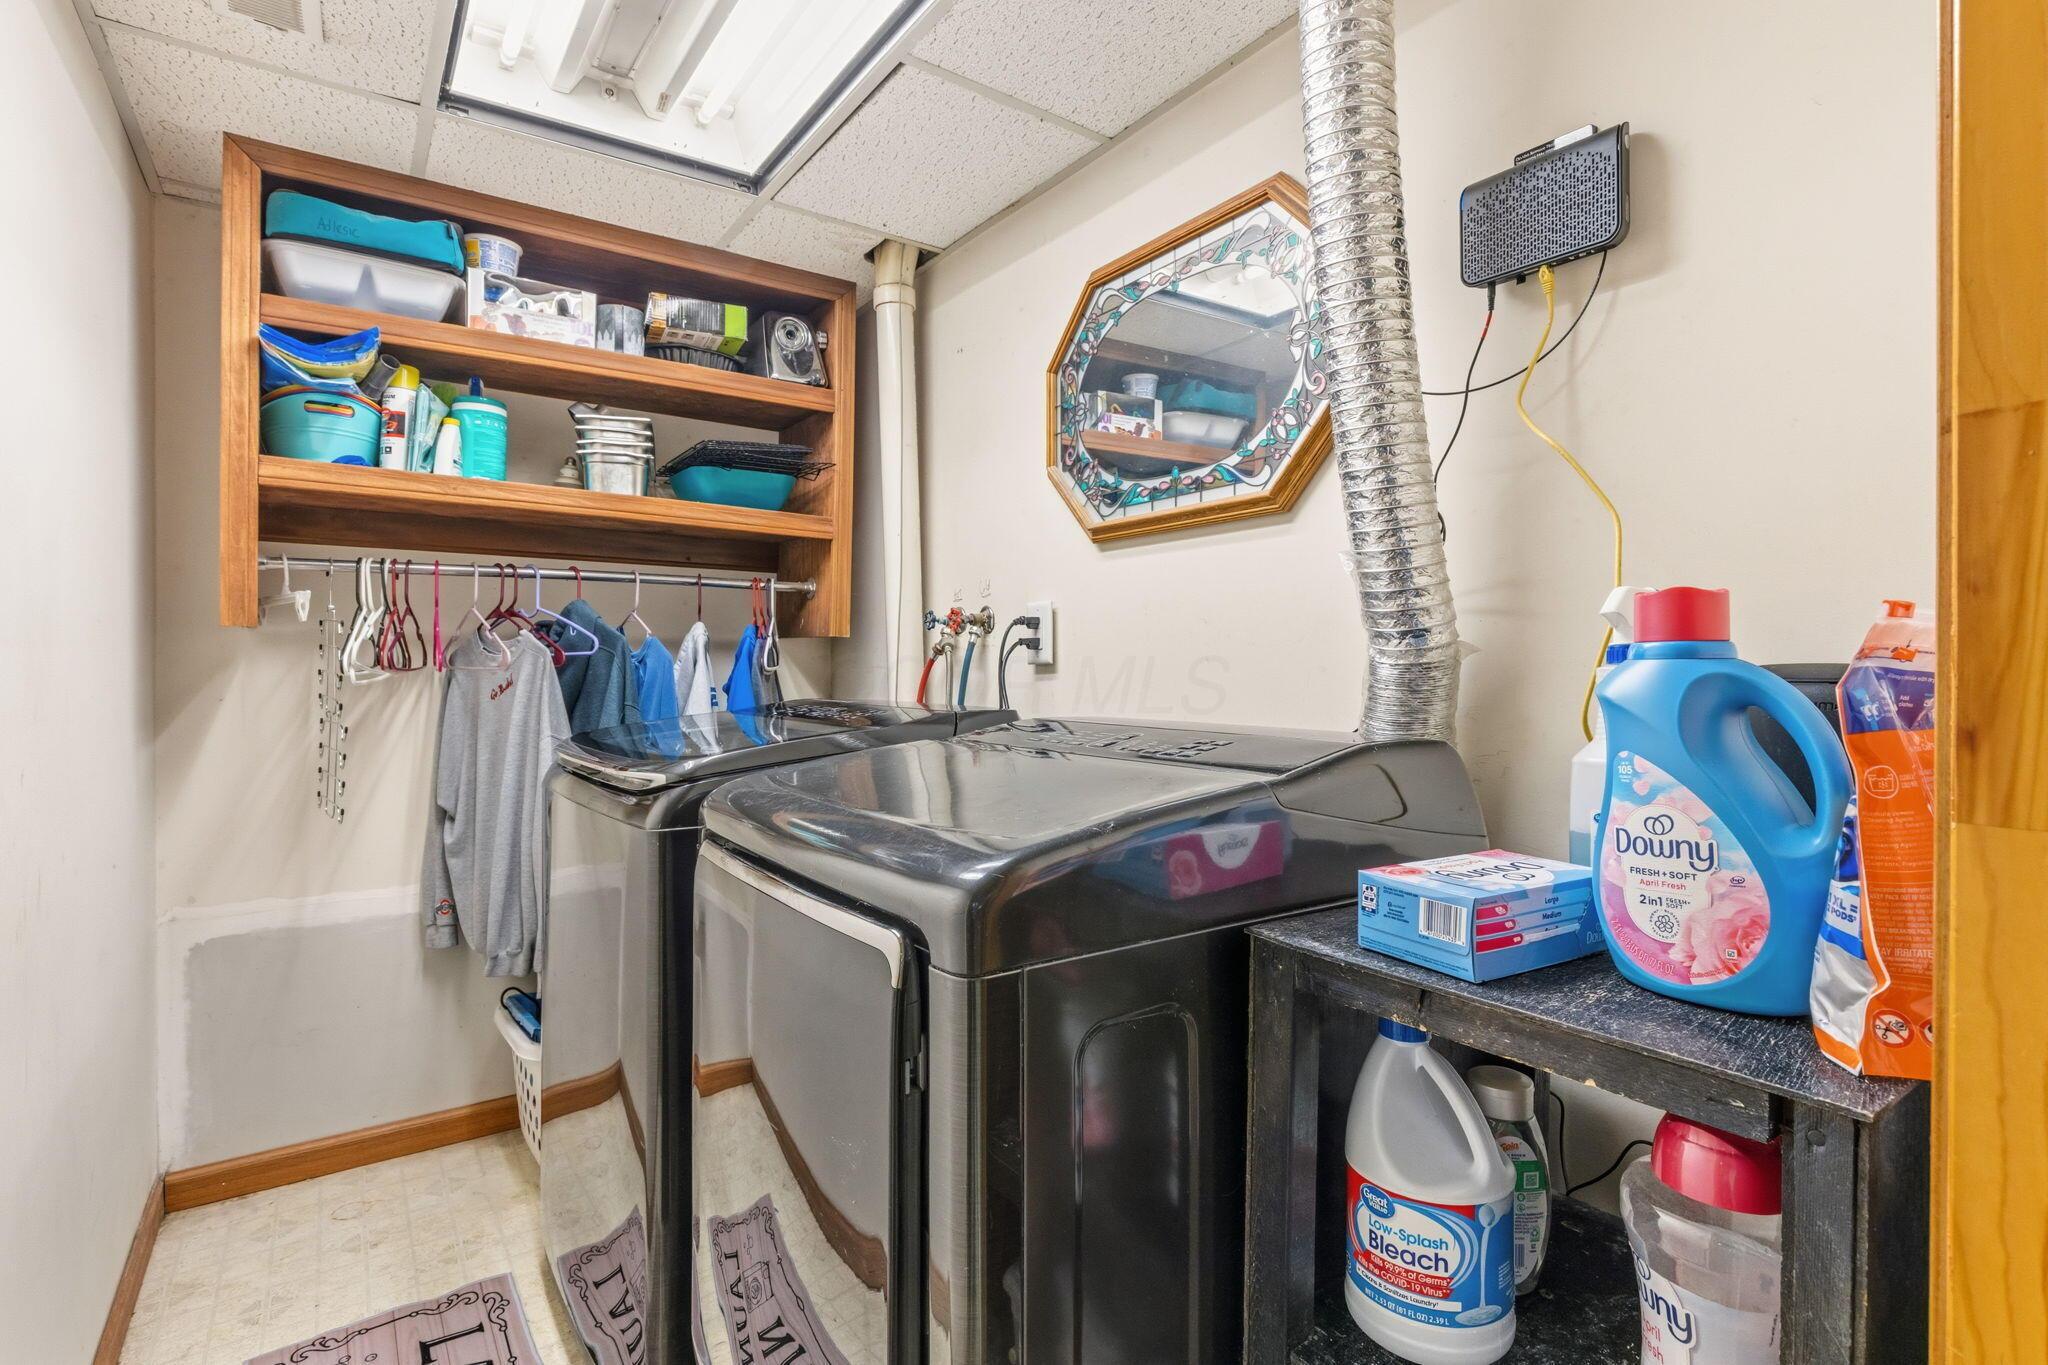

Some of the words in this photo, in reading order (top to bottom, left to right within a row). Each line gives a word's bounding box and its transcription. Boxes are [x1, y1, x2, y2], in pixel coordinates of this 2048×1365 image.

[1617, 765, 1633, 774] 105
[1615, 827, 1715, 873] Downy
[1629, 866, 1661, 878] FRESH
[1668, 871, 1698, 882] SOFT
[1639, 878, 1660, 888] April
[1661, 881, 1687, 891] Fresh
[1544, 896, 1559, 905] Large
[1542, 910, 1562, 920] Medium
[1363, 1187, 1388, 1208] Great
[1368, 1214, 1449, 1251] Low-Splash
[1368, 1229, 1449, 1273] Bleach
[1370, 1253, 1384, 1267] Kills
[1384, 1261, 1407, 1277] 99.9%
[1380, 1270, 1421, 1292] COVID-19
[1383, 1284, 1410, 1301] Sanitizes
[1416, 1312, 1429, 1322] OZ)
[1429, 1316, 1445, 1325] 2.39
[1640, 1279, 1693, 1345] wny
